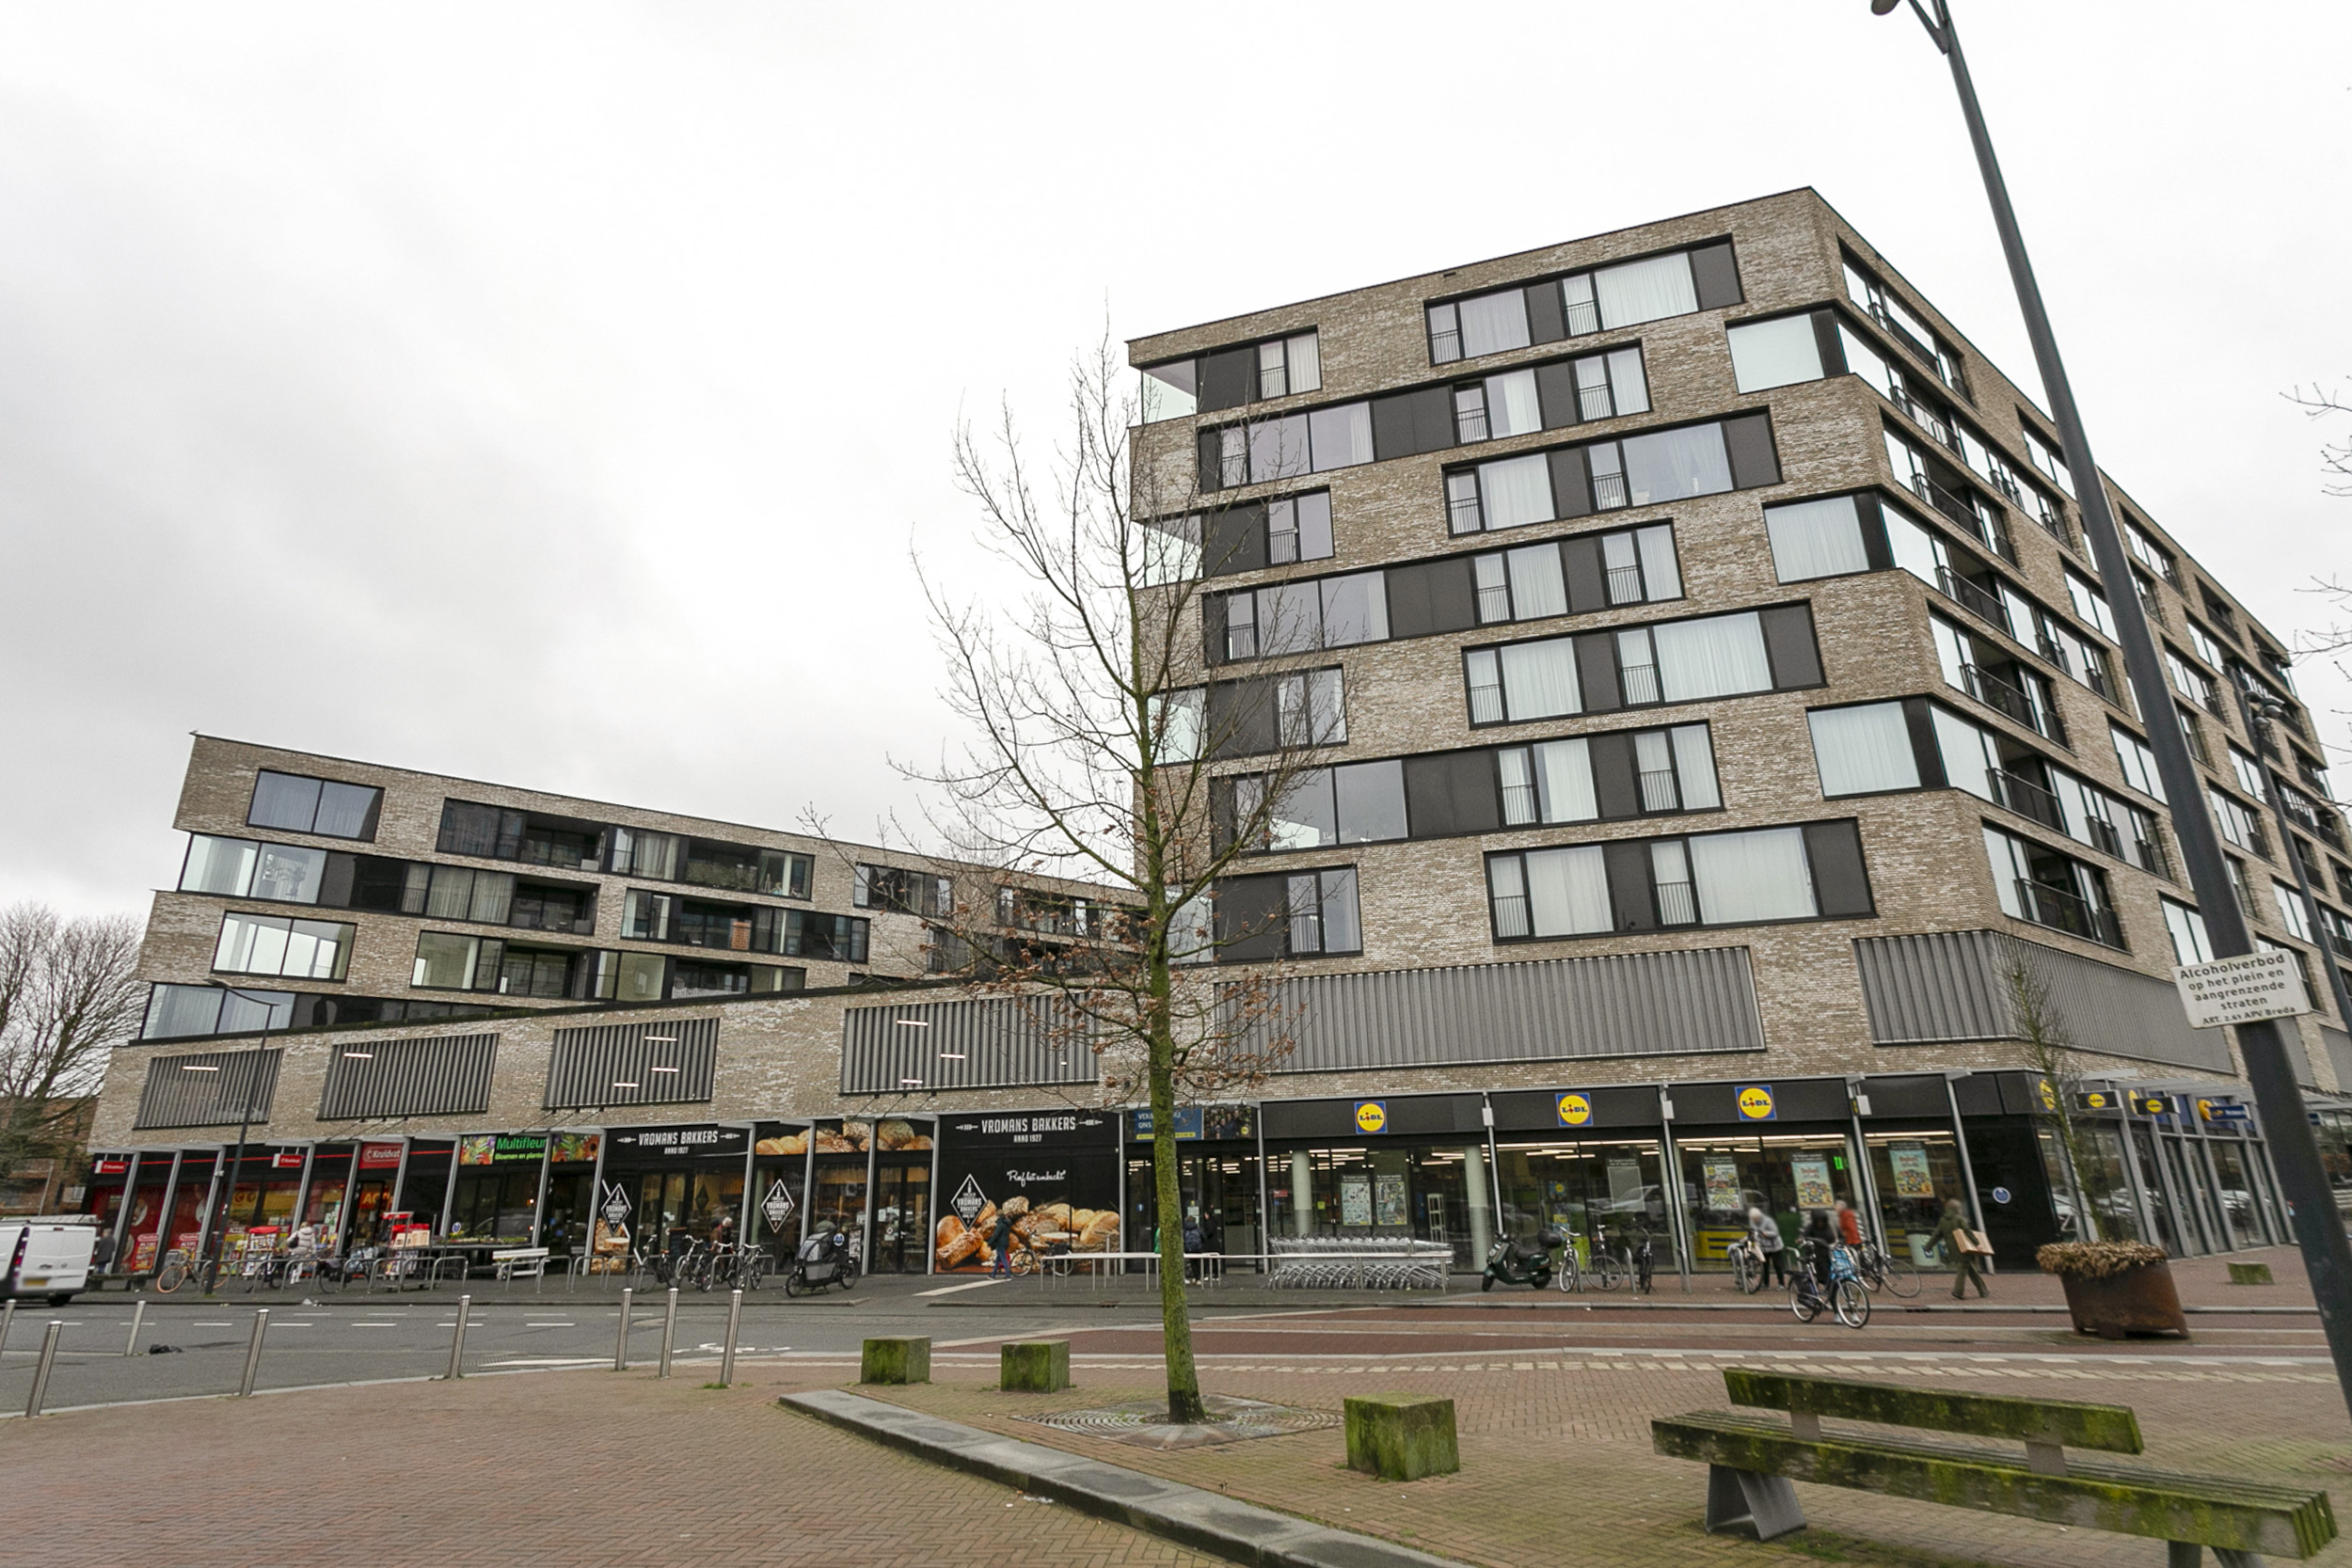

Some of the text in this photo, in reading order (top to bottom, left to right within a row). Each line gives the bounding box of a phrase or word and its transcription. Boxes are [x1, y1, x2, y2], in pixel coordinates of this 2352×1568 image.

[2180, 954, 2285, 979] Alcoholverbod
[2188, 968, 2284, 991] op het plein en
[2195, 981, 2285, 1002] aangrenzende
[2220, 996, 2267, 1010] straten
[2202, 1006, 2296, 1025] ART. 2.61 APV Breda
[981, 1117, 1076, 1133] VROMANS BAKKERS
[497, 1137, 547, 1150] Multifleur
[639, 1131, 719, 1146] VROMANS BAKKERS
[1013, 1133, 1042, 1143] ANNO 1927
[373, 1149, 401, 1159] Kruidvat
